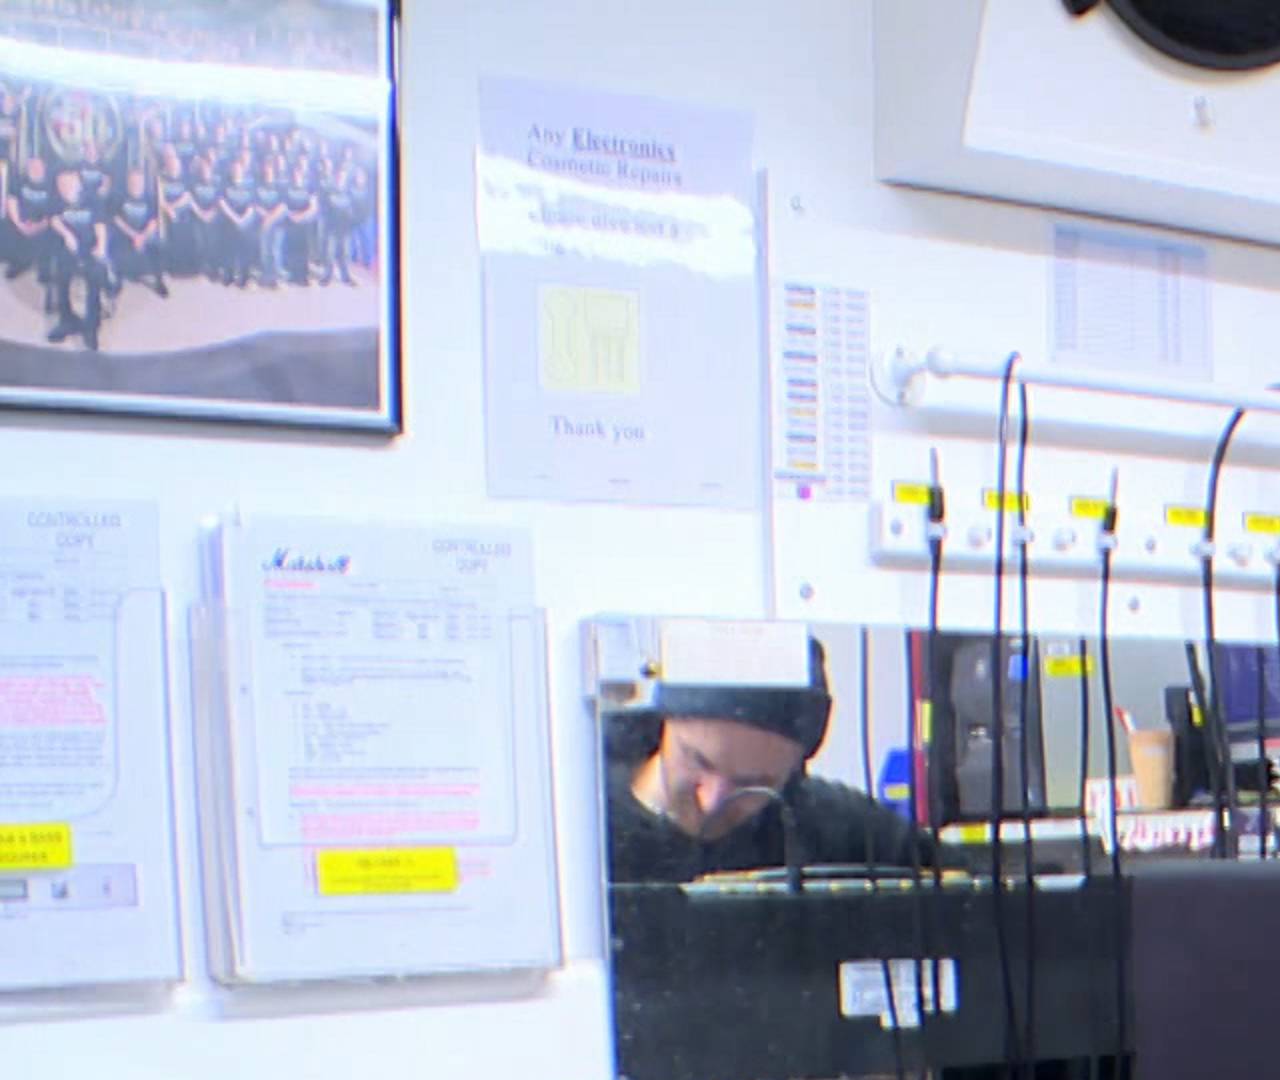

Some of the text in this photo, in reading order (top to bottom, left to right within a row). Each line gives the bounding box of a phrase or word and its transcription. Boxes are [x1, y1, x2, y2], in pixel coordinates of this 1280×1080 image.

[528, 123, 677, 163] Any Electronics
[527, 152, 683, 187] Cosmetic Repairs
[550, 414, 646, 446] Thank you
